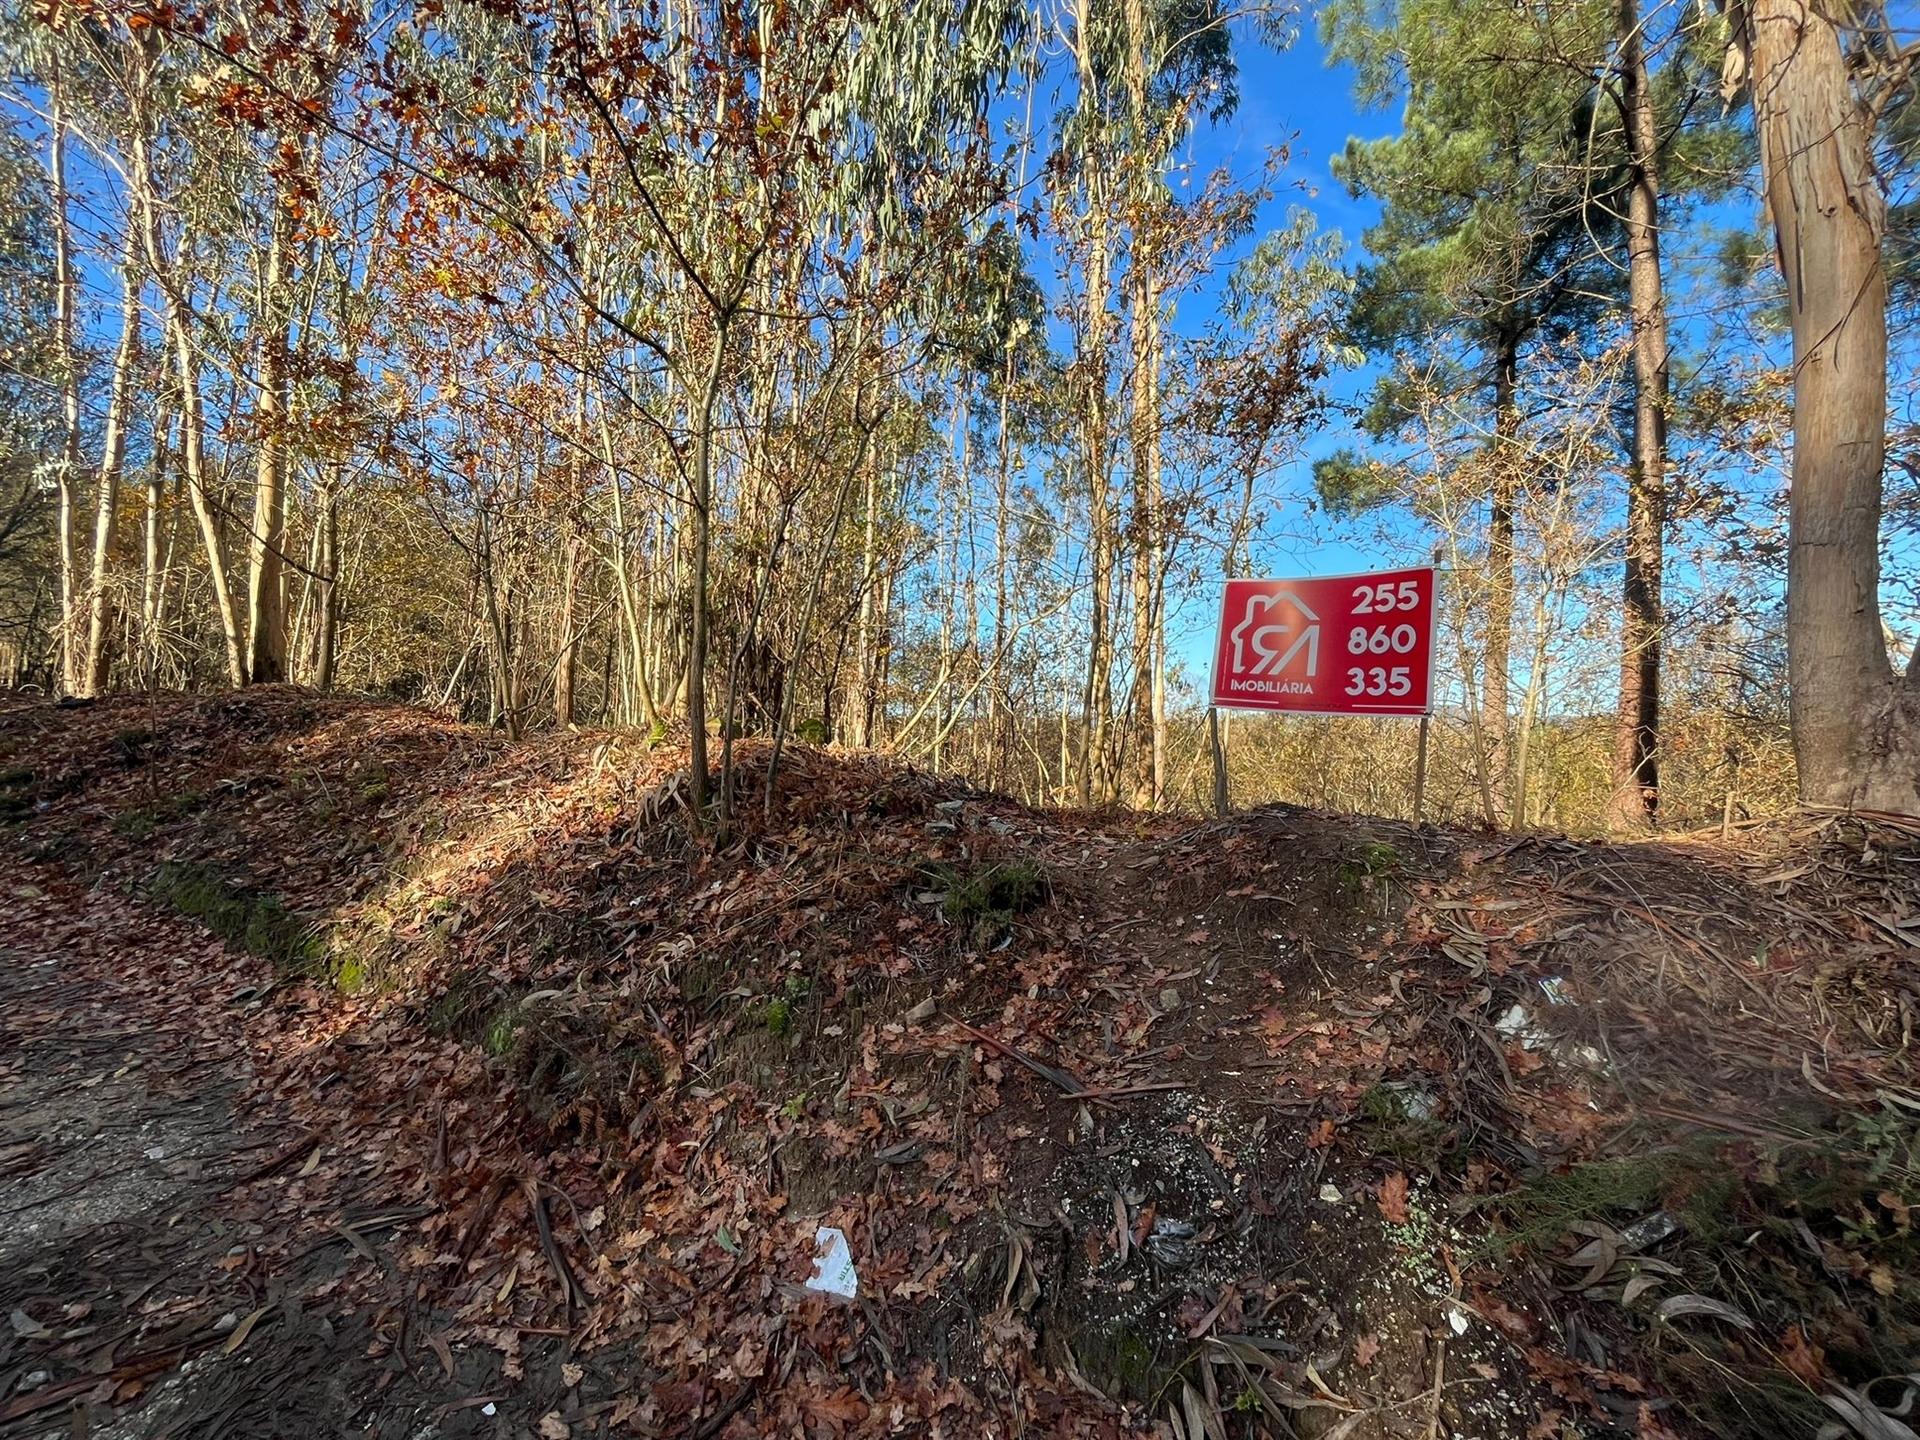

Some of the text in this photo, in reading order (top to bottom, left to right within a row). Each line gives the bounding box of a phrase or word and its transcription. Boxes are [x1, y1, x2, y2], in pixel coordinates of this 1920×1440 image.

[1351, 581, 1419, 614] 255
[1348, 624, 1416, 654] 860
[1230, 678, 1313, 694] IMOBILIÁRIA
[1344, 667, 1412, 696] 335
